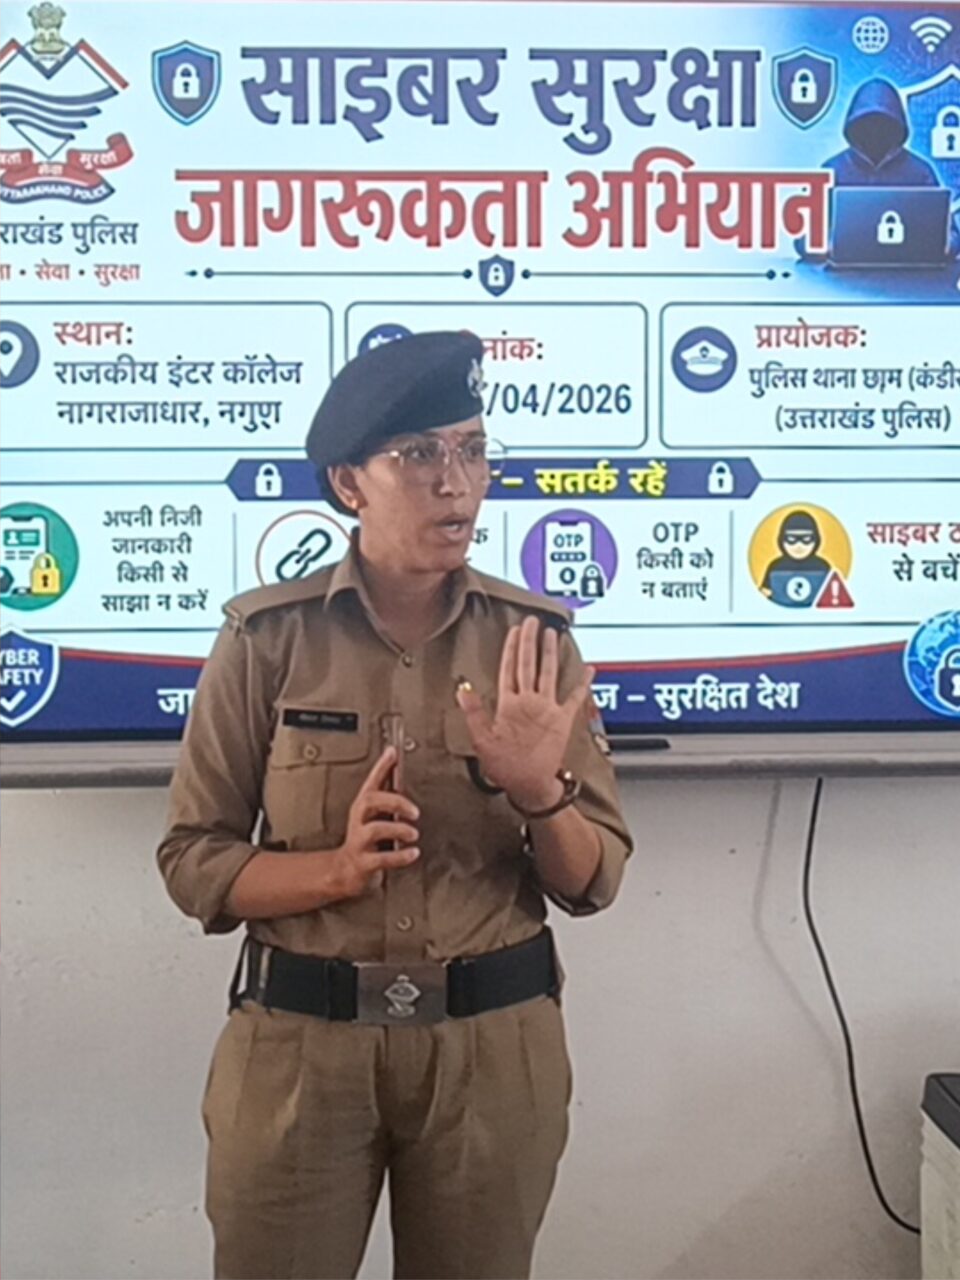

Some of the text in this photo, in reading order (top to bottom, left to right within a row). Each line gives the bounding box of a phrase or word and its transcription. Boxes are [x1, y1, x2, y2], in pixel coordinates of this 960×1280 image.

[240, 46, 762, 156] साइबर सुरक्षा
[0, 183, 72, 199] TTARAKHAND
[174, 146, 831, 250] जागरूकता अभियान
[0, 214, 139, 254] राखंड पुलिस
[35, 258, 70, 280] सेवा
[94, 263, 141, 287] सुरक्षा
[54, 321, 133, 346] स्थान:
[480, 329, 543, 361] नांक:
[755, 318, 867, 349] प्रायोजक:
[54, 353, 303, 388] राजकीय इंटर कॉलेज
[749, 363, 807, 398] पुलिस
[813, 368, 857, 389] थाना
[908, 360, 960, 392] (कंडी
[486, 382, 632, 417] /04/2026
[57, 401, 210, 428] नागराजाधार,
[775, 400, 952, 438] (उत्तराखंड पुलिस)
[534, 459, 619, 496] सतर्क
[629, 460, 668, 497] रहें
[102, 505, 203, 528] अपनी निजी
[112, 533, 192, 555] जानकारी
[553, 533, 584, 548] OTP
[653, 522, 699, 545] OTP
[866, 522, 942, 547] साइबर
[117, 561, 189, 584] किसी से
[637, 549, 714, 570] किसी को
[892, 552, 915, 581] से
[102, 589, 209, 613] साझा न करें
[642, 583, 657, 599] न
[0, 668, 44, 685] FETY
[653, 673, 750, 720] सुरक्षित
[756, 673, 801, 711] देश
